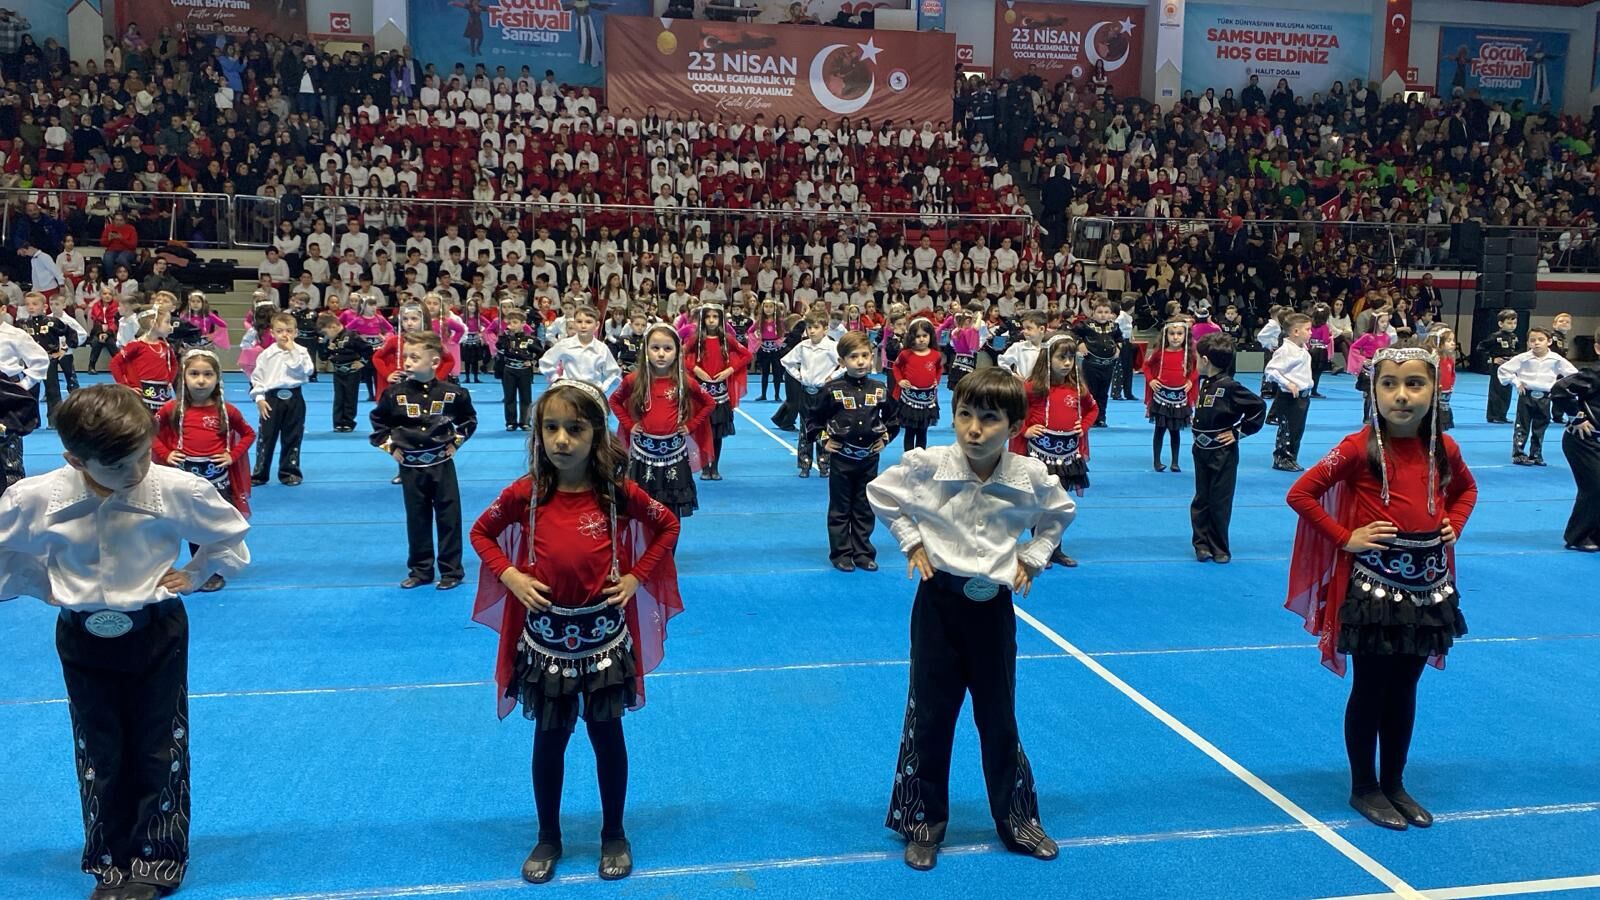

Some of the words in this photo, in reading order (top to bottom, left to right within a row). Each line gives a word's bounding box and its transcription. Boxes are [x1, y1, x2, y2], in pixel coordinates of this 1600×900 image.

[332, 17, 351, 30] C3
[488, 8, 571, 31] Festivali
[1217, 17, 1233, 25] TÜRK
[502, 29, 560, 42] Samsun
[1011, 28, 1030, 42] 23
[1034, 27, 1081, 45] NİSAN
[1207, 28, 1340, 48] SAMSUN'UMUZA
[957, 48, 974, 60] C2
[1036, 44, 1070, 52] EGEMENLİK
[1217, 46, 1252, 63] HOŞ
[1255, 47, 1329, 64] GELDİNİZ
[1481, 43, 1527, 61] Çocuk
[688, 52, 716, 71] 23
[723, 51, 798, 75] NİSAN
[1471, 59, 1533, 79] Festivali
[687, 72, 724, 82] ULUSAL
[727, 74, 781, 85] EGEMENLİK
[783, 76, 796, 86] VE
[1479, 77, 1522, 88] Samsun
[692, 83, 728, 94] ÇOCUK
[730, 85, 793, 96] BAYRAMIMIZ
